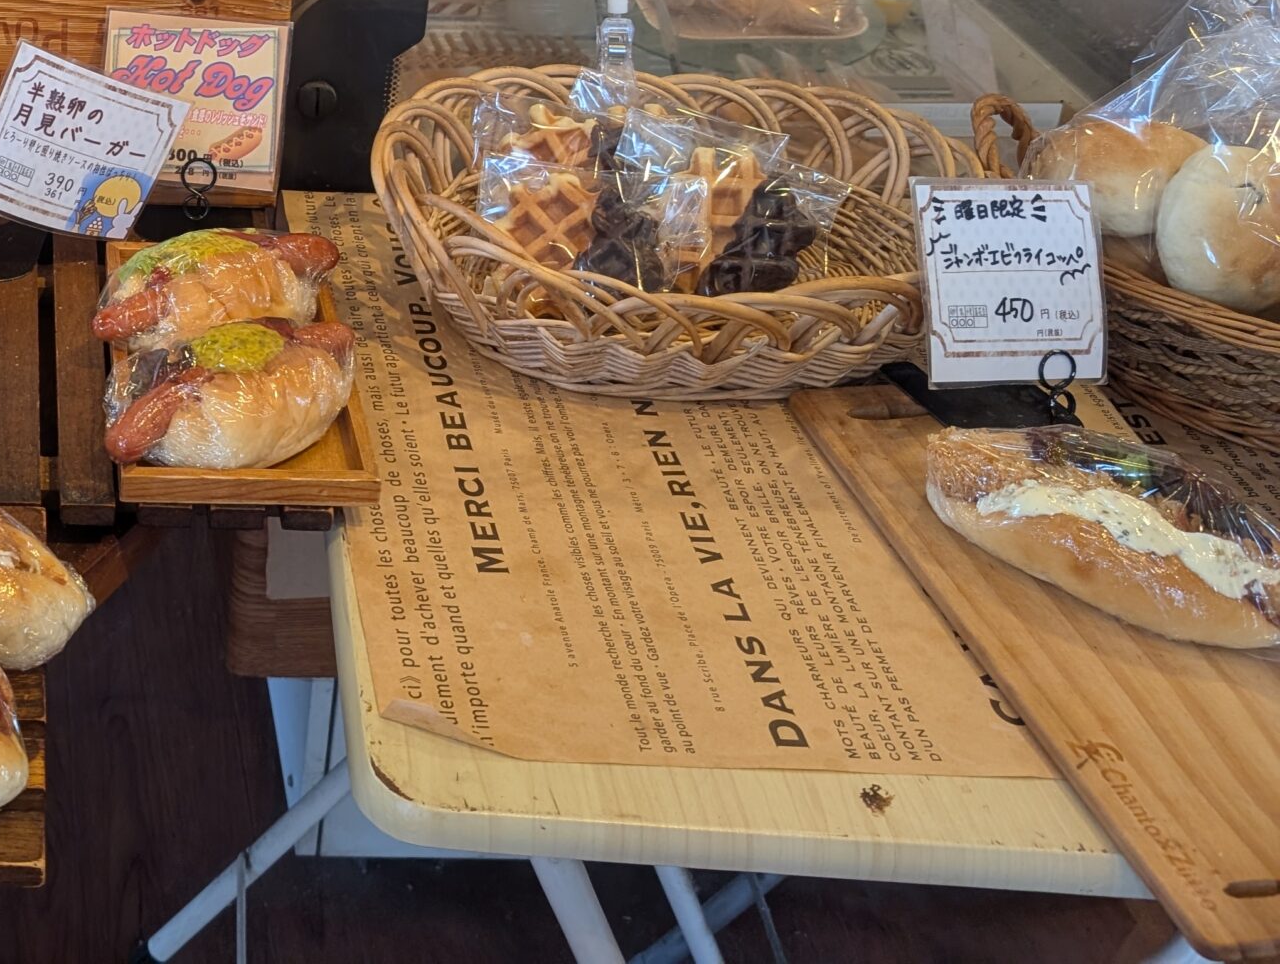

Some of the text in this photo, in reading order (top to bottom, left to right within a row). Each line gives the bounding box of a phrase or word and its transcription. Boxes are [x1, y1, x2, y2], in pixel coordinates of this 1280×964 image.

[125, 23, 270, 58] ホットドッグ
[27, 81, 104, 124] 半熟卵の
[111, 54, 275, 112] Hot Dog
[12, 103, 146, 159] 月見バーガー
[44, 172, 75, 192] 390
[44, 187, 63, 200] 361
[954, 194, 1027, 220] 曜日限定
[940, 242, 1084, 270] ジャンボエビフライコッペ
[994, 297, 1034, 323] 450
[372, 312, 399, 369] appartient
[388, 371, 405, 398] futur
[402, 429, 423, 467] soient
[356, 353, 439, 646] d'achever beaucoup choses, mais aussi
[413, 471, 437, 525] qu'elles
[712, 468, 739, 511] BEAUTÉ
[782, 480, 824, 548] FINALEMENT
[458, 466, 504, 574] MERCI
[427, 530, 452, 580] quelles
[735, 517, 778, 590] DEVIENNENT
[776, 530, 810, 582] L'ESPOIR
[384, 574, 406, 621] toutes
[547, 589, 563, 623] Anatole
[597, 568, 620, 607] montant
[807, 557, 847, 623] MONTAGNE
[822, 552, 858, 612] PARVENIR
[447, 604, 471, 655] quand
[617, 569, 660, 661] Gardez votre visage
[683, 624, 697, 647] Place
[734, 478, 881, 760] BEAUTÉ LEURS RÊVES VOTRE ESPOIR
[396, 628, 415, 668] pour
[559, 625, 576, 659] avenue
[568, 536, 650, 752] Tout monde recherche choses visibles
[817, 614, 856, 672] LUMIÈRE
[866, 639, 899, 691] PERMET
[633, 674, 652, 699] fond
[736, 636, 808, 748] DANS
[788, 629, 836, 710] CHARMEURS
[833, 719, 861, 759] MOTS
[877, 696, 919, 761] MONTANT
